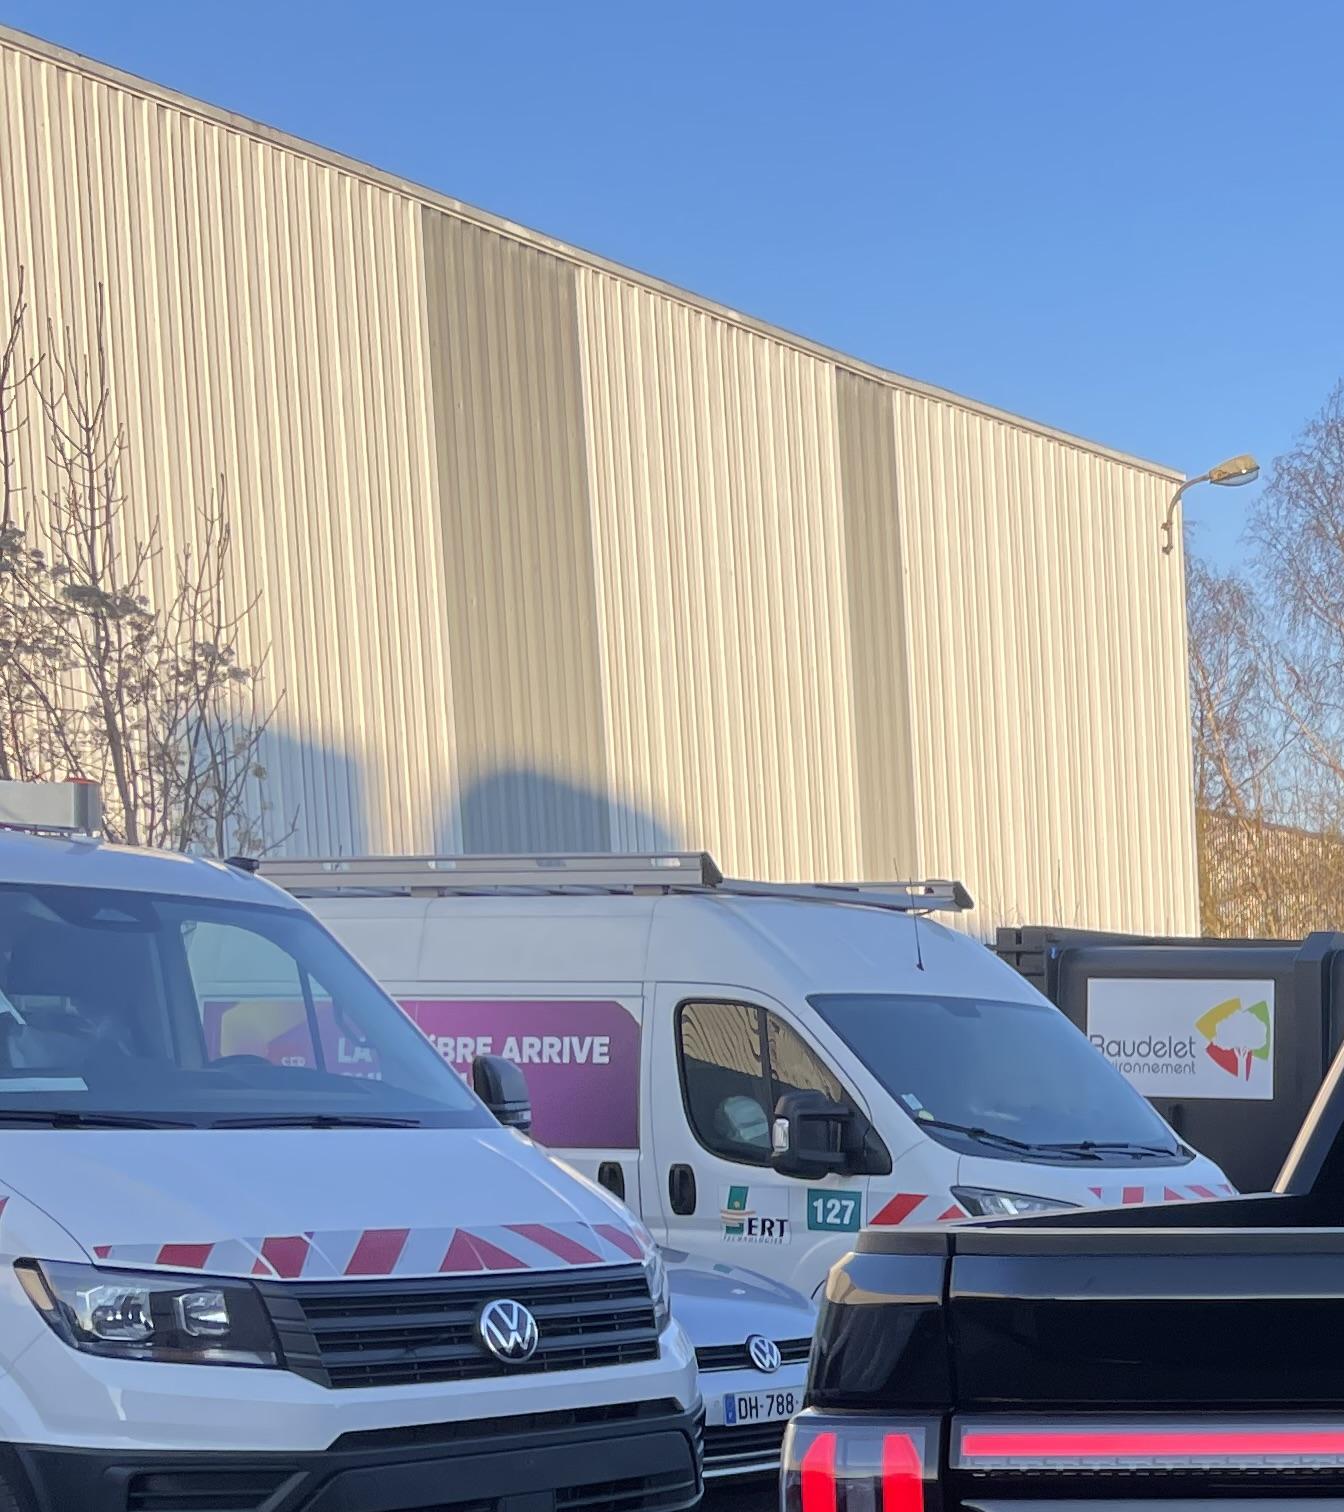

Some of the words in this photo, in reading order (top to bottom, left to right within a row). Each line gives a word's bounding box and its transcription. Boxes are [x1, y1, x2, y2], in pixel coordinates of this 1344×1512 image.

[429, 1034, 493, 1064] BRE
[501, 1036, 610, 1065] ARRIVE
[1112, 1060, 1197, 1075] ironnement
[812, 1198, 855, 1225] 127
